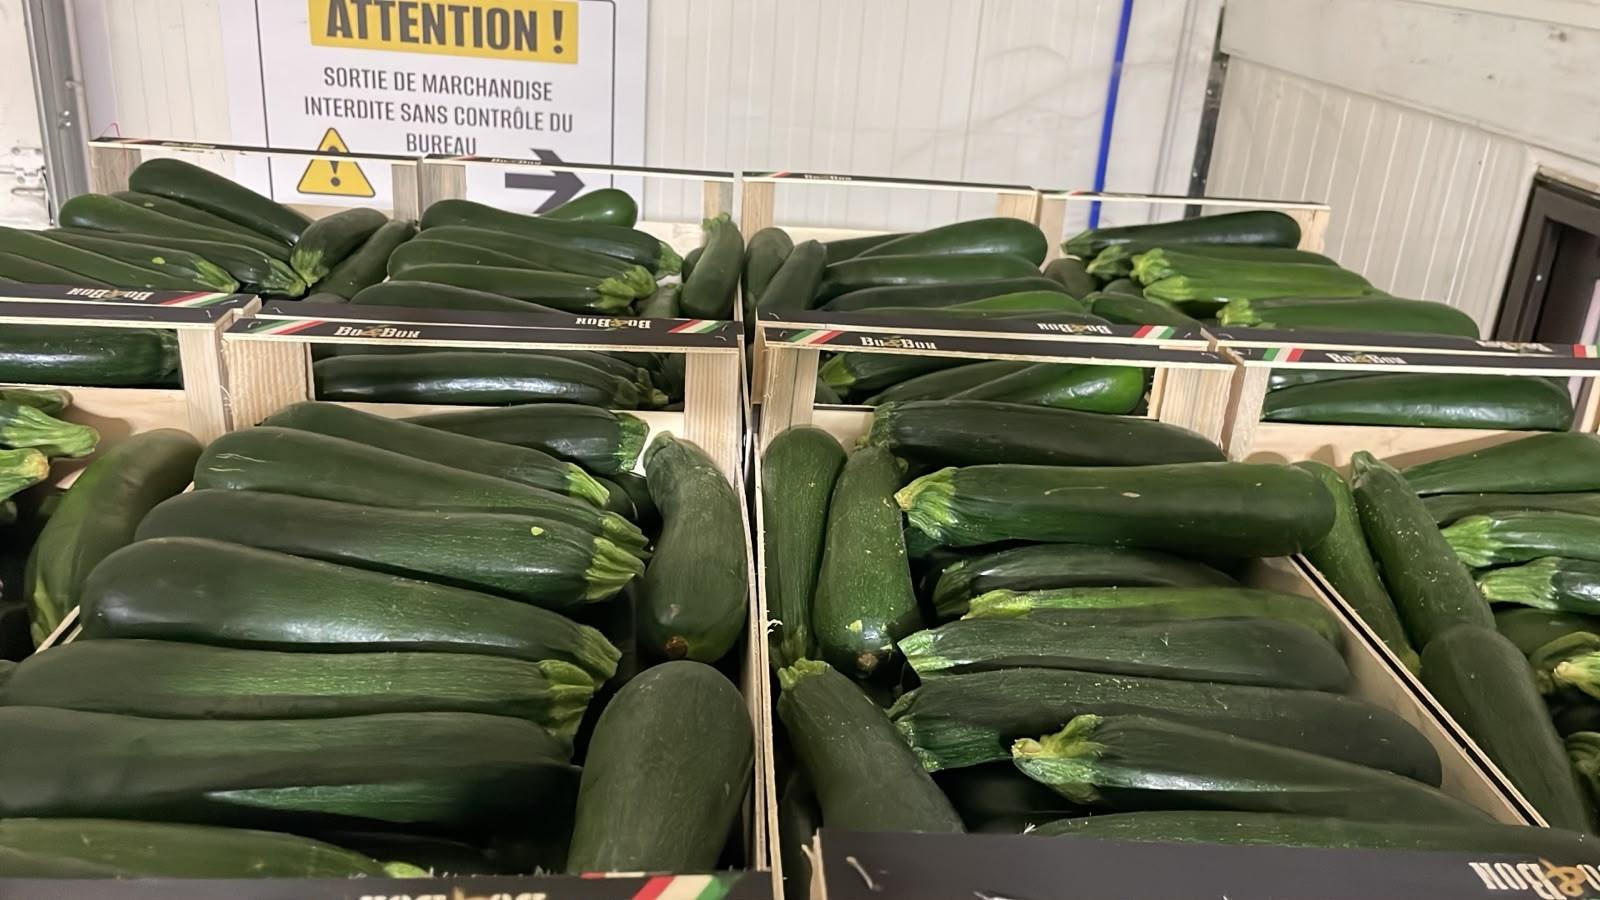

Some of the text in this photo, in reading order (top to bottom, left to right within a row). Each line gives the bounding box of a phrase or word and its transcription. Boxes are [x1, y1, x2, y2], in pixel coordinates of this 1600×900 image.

[326, 0, 564, 55] ATTENTION !
[323, 66, 553, 101] SORTIE DE MARCHANDISE
[304, 96, 573, 133] INTERDITE SANS CONTRÔLE DU
[405, 133, 477, 155] BUREAU
